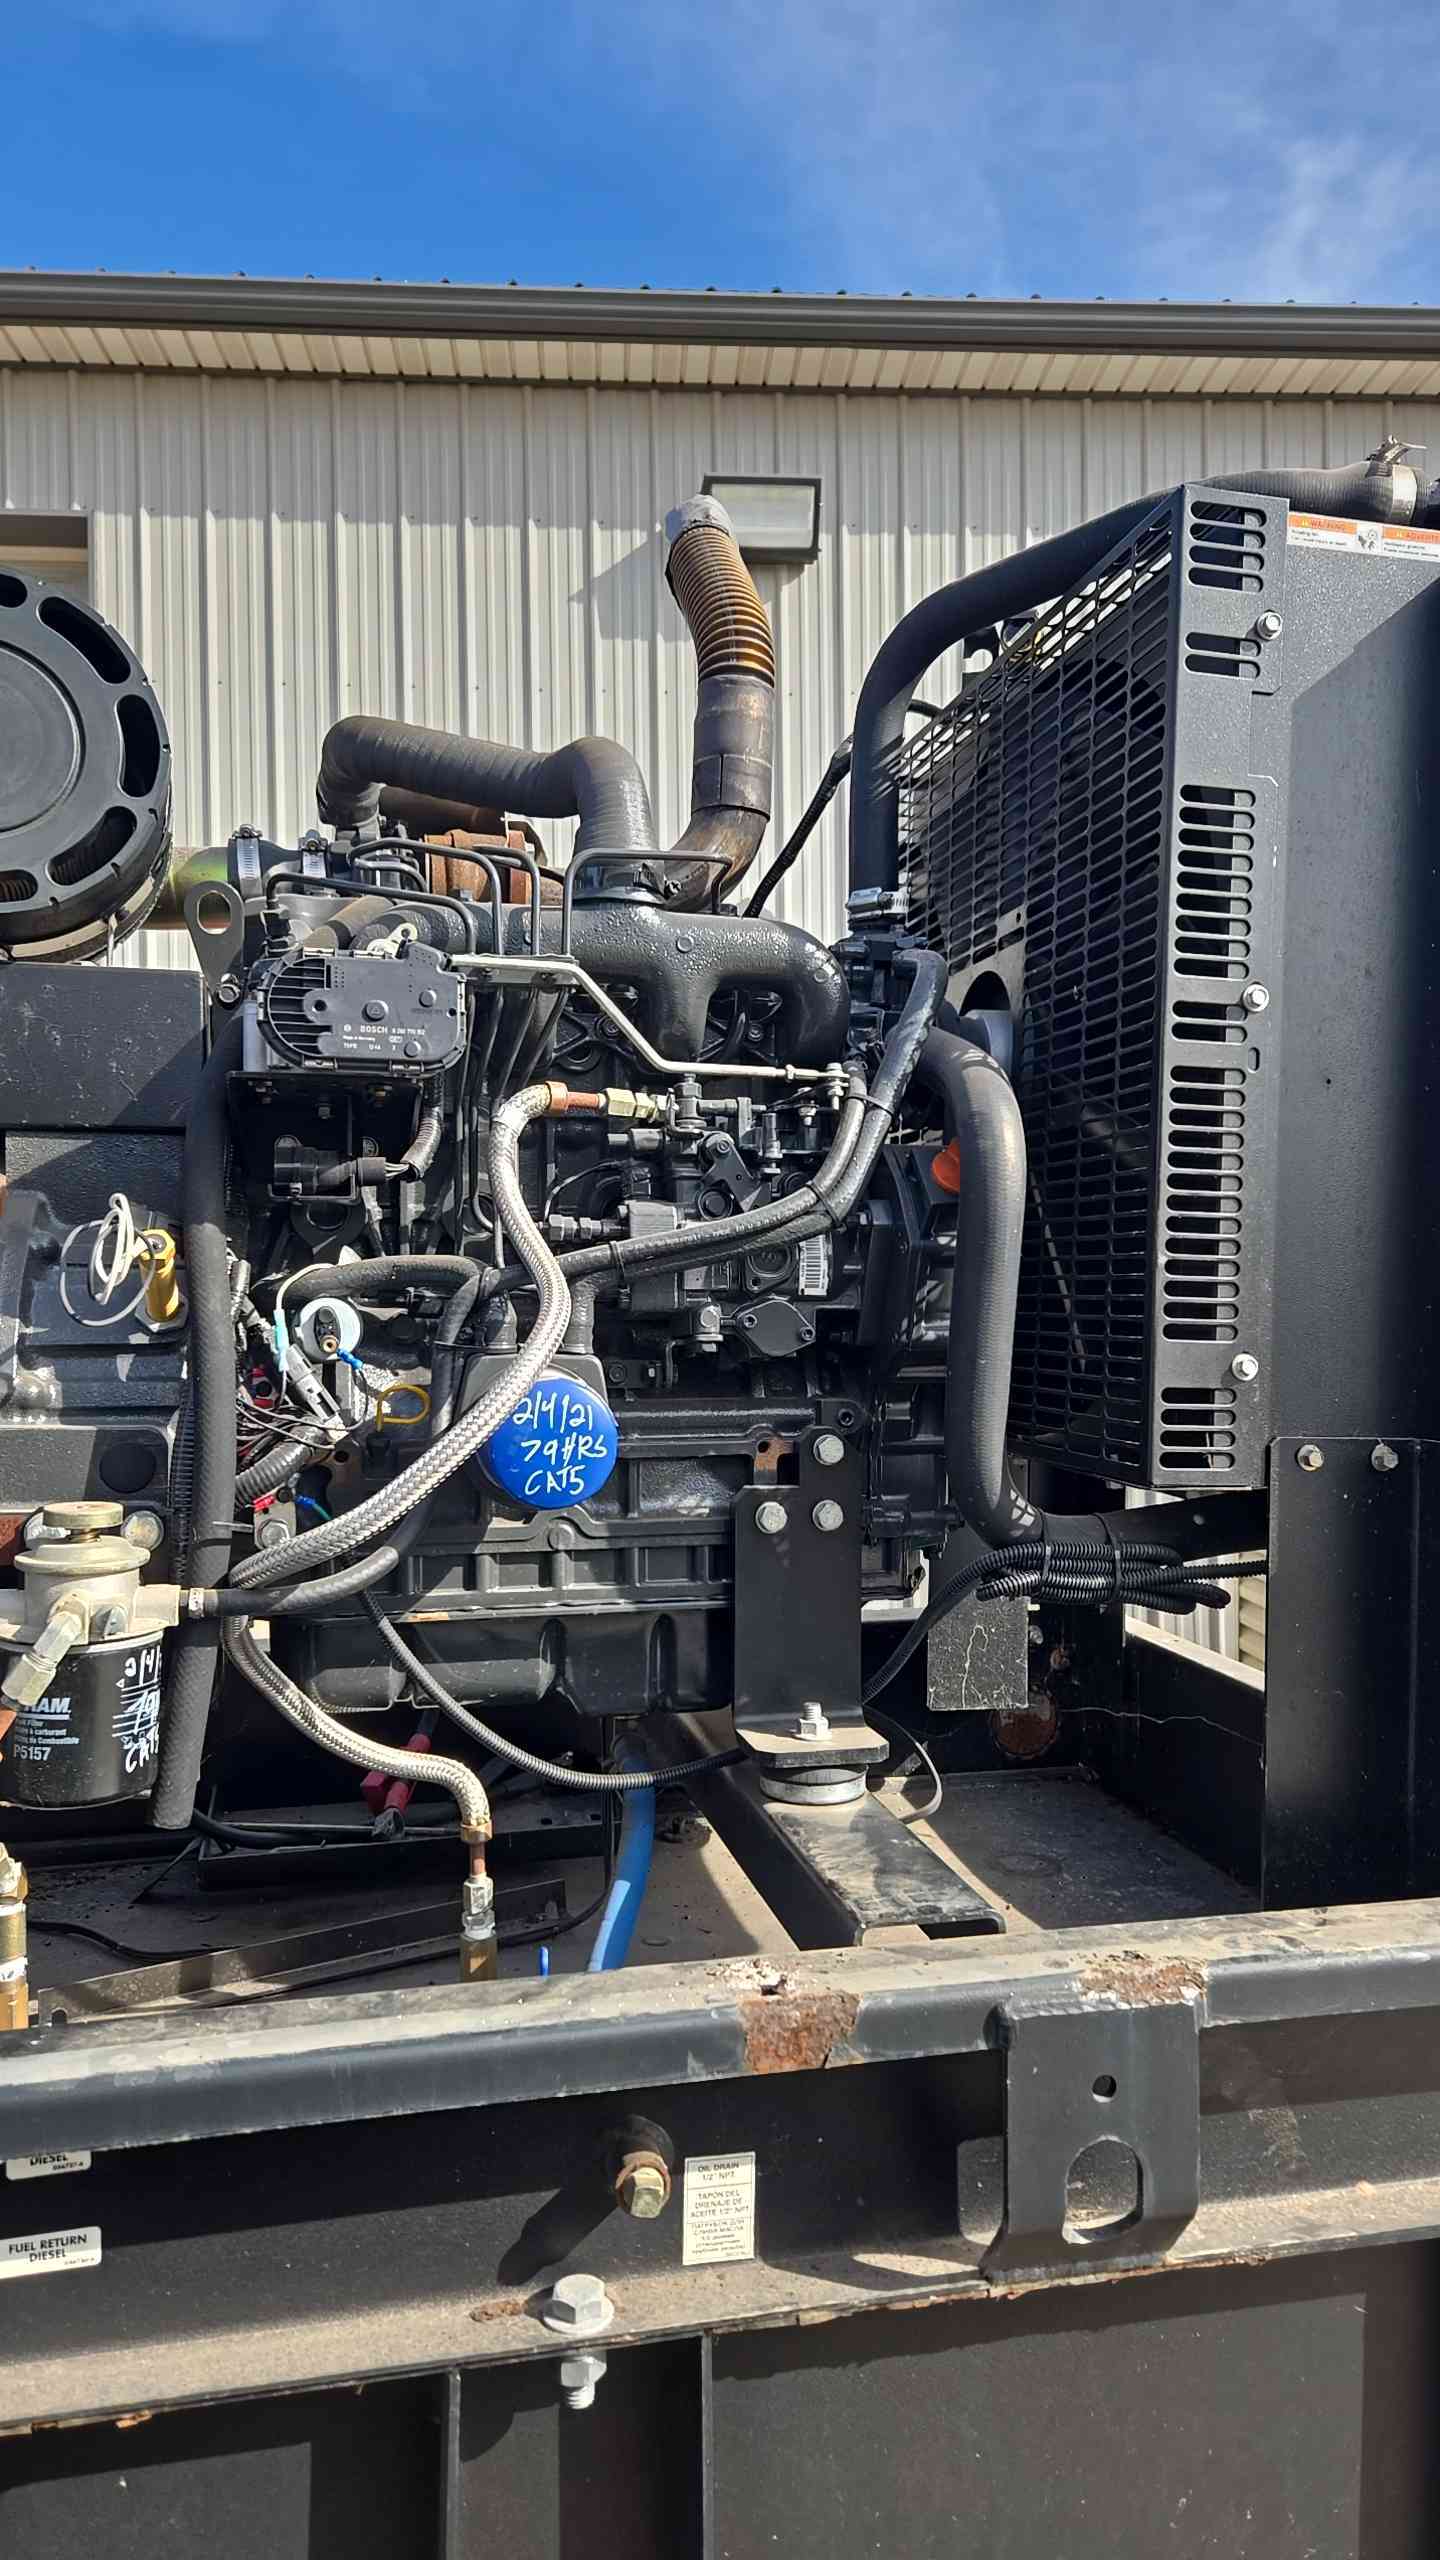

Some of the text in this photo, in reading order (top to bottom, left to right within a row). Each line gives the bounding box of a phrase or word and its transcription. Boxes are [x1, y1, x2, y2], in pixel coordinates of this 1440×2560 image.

[360, 1025, 388, 1034] BOSCH
[512, 1391, 593, 1433] 2/4/21
[524, 1465, 586, 1496] CAT5
[713, 2161, 740, 2171] DRAIN
[9, 2234, 88, 2255] FUEL RETURN
[29, 2249, 67, 2262] DIESEL
